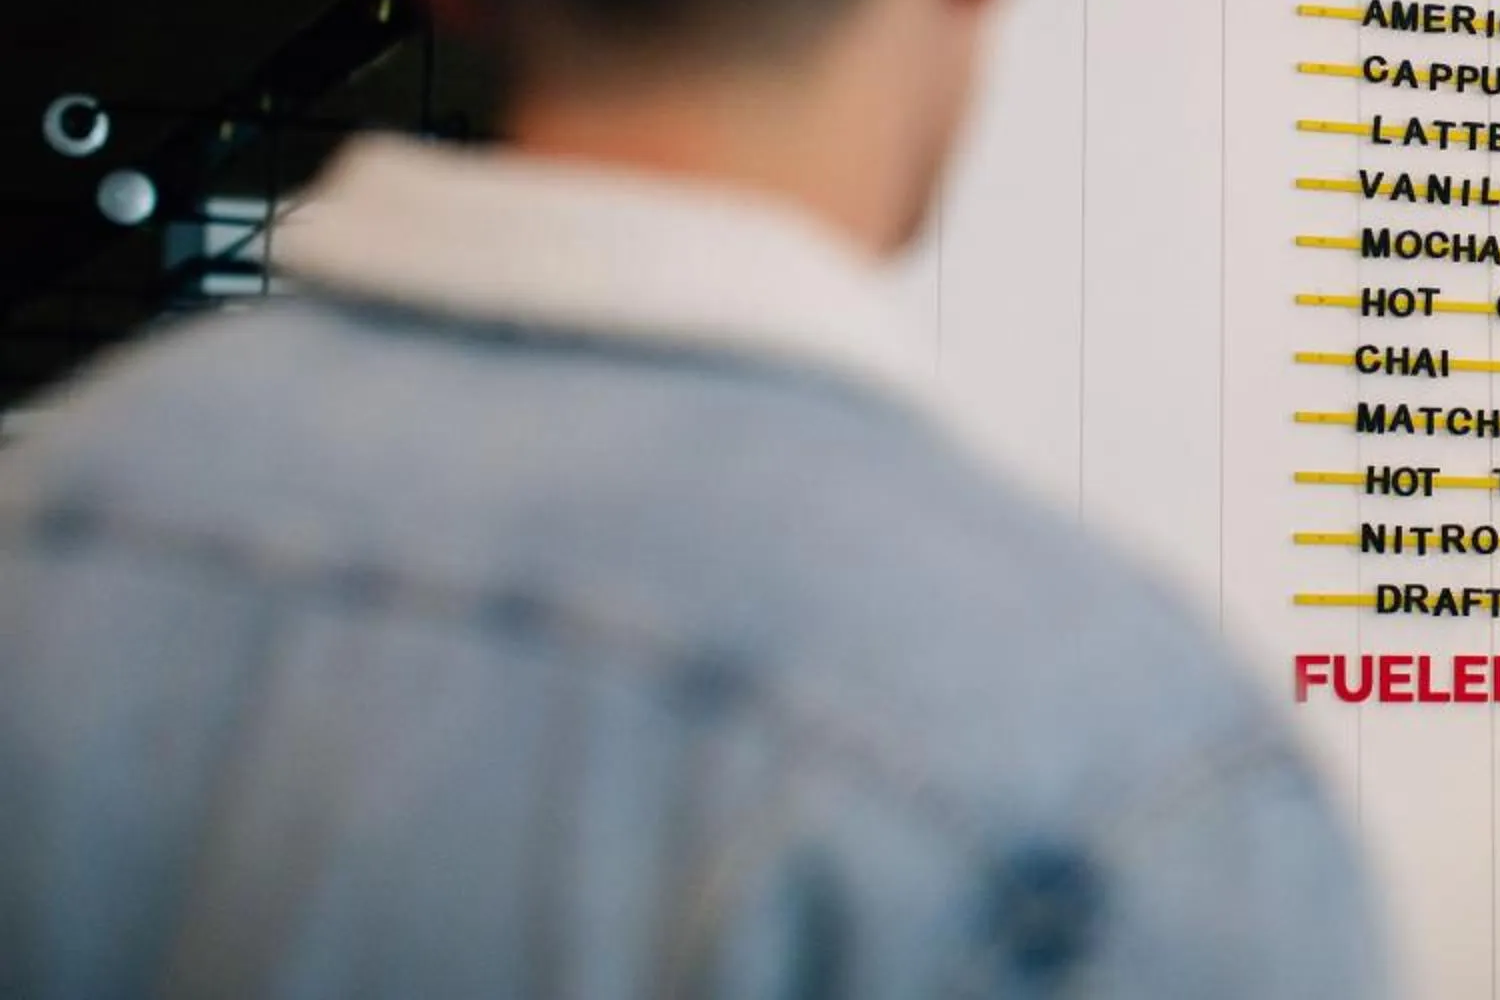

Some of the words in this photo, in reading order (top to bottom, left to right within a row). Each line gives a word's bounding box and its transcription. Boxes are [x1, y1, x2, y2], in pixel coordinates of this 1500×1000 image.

[1360, 287, 1441, 319] HOT
[1354, 344, 1449, 379] CHAI
[1365, 465, 1441, 497] HOT
[1359, 522, 1499, 557] NITRO
